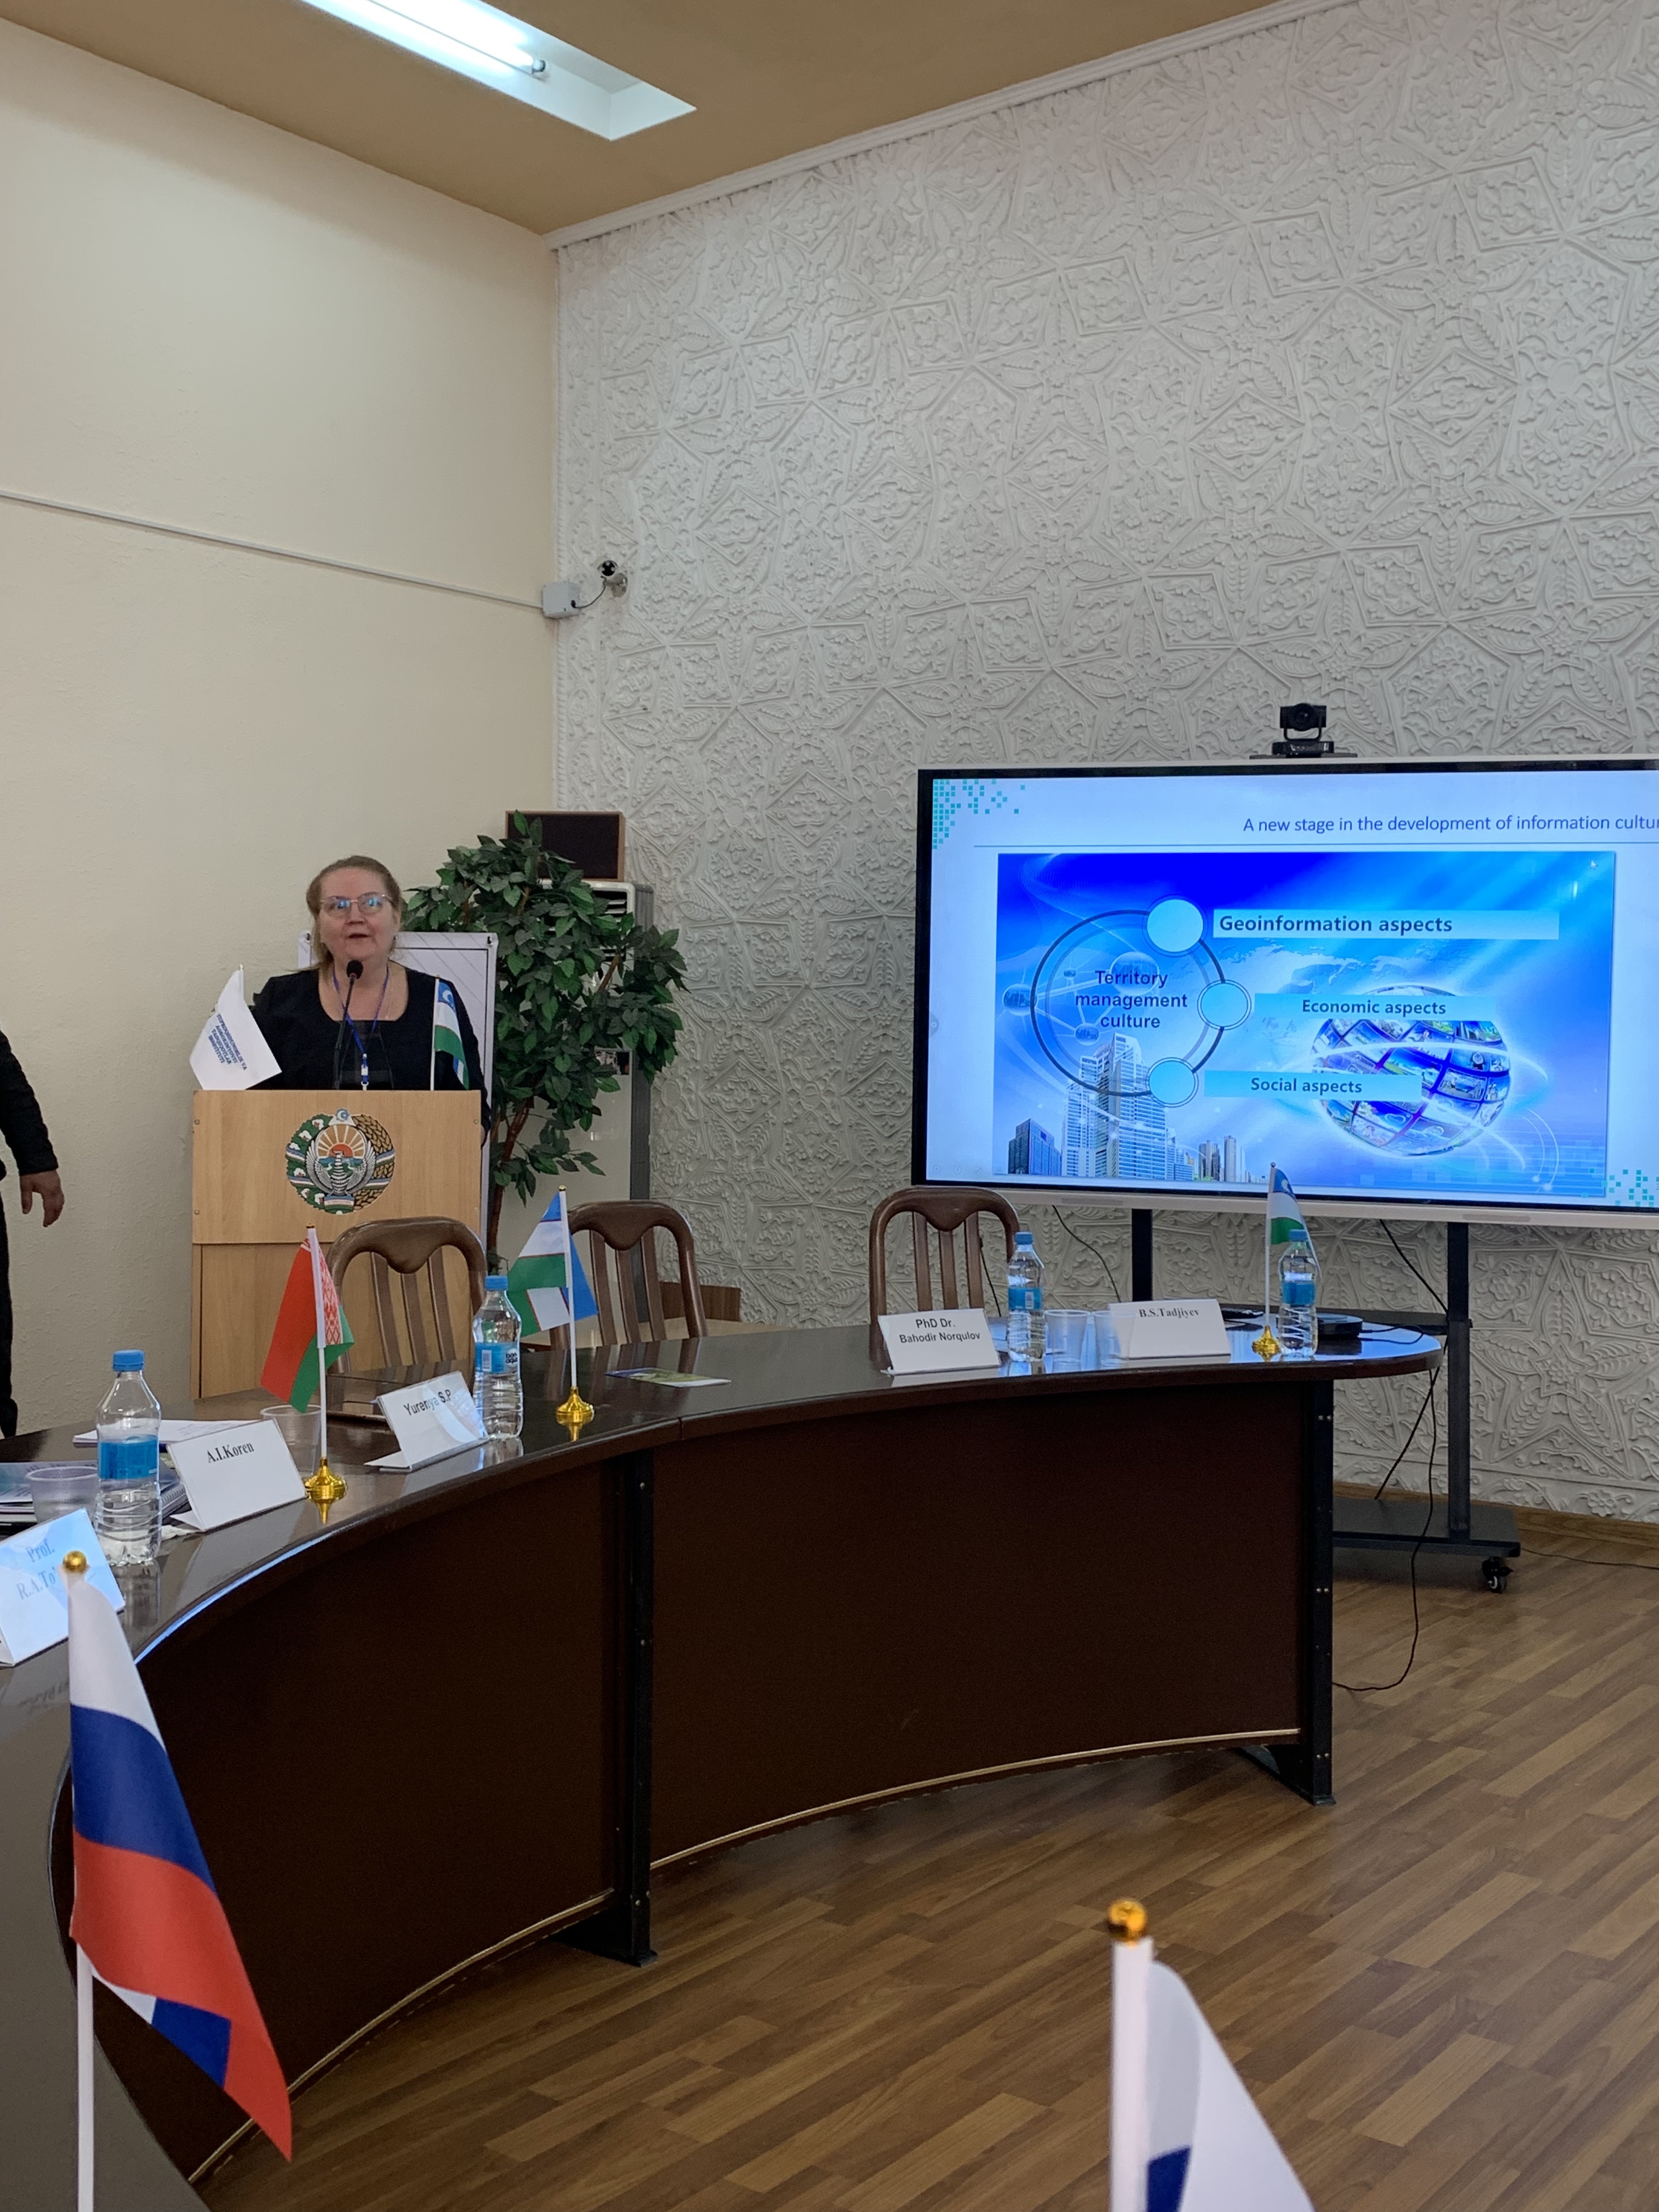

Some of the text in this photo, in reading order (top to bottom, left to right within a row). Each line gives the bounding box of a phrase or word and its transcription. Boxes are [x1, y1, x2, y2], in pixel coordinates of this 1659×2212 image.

[1243, 819, 1254, 831] A
[1258, 820, 1290, 831] new
[1294, 819, 1334, 834] stage
[1339, 817, 1353, 831] in
[1357, 816, 1383, 831] the
[1388, 816, 1491, 833] development
[1496, 815, 1513, 830] of
[1516, 815, 1610, 830] information
[1219, 915, 1453, 936] Geoinformation aspects
[1094, 970, 1169, 989] Territory
[1075, 994, 1188, 1010] management
[1302, 1000, 1446, 1017] Economic aspects
[1101, 1014, 1161, 1028] culture
[1251, 1077, 1363, 1096] Social aspects
[1138, 1307, 1200, 1318] B.S.Tadjiyev
[915, 1318, 956, 1328] PhD Dr.
[899, 1331, 980, 1344] Bahodir Norqulov
[403, 1397, 439, 1416] Yurenya
[207, 1442, 255, 1464] A.I.Koren
[25, 1538, 55, 1562] Prof.
